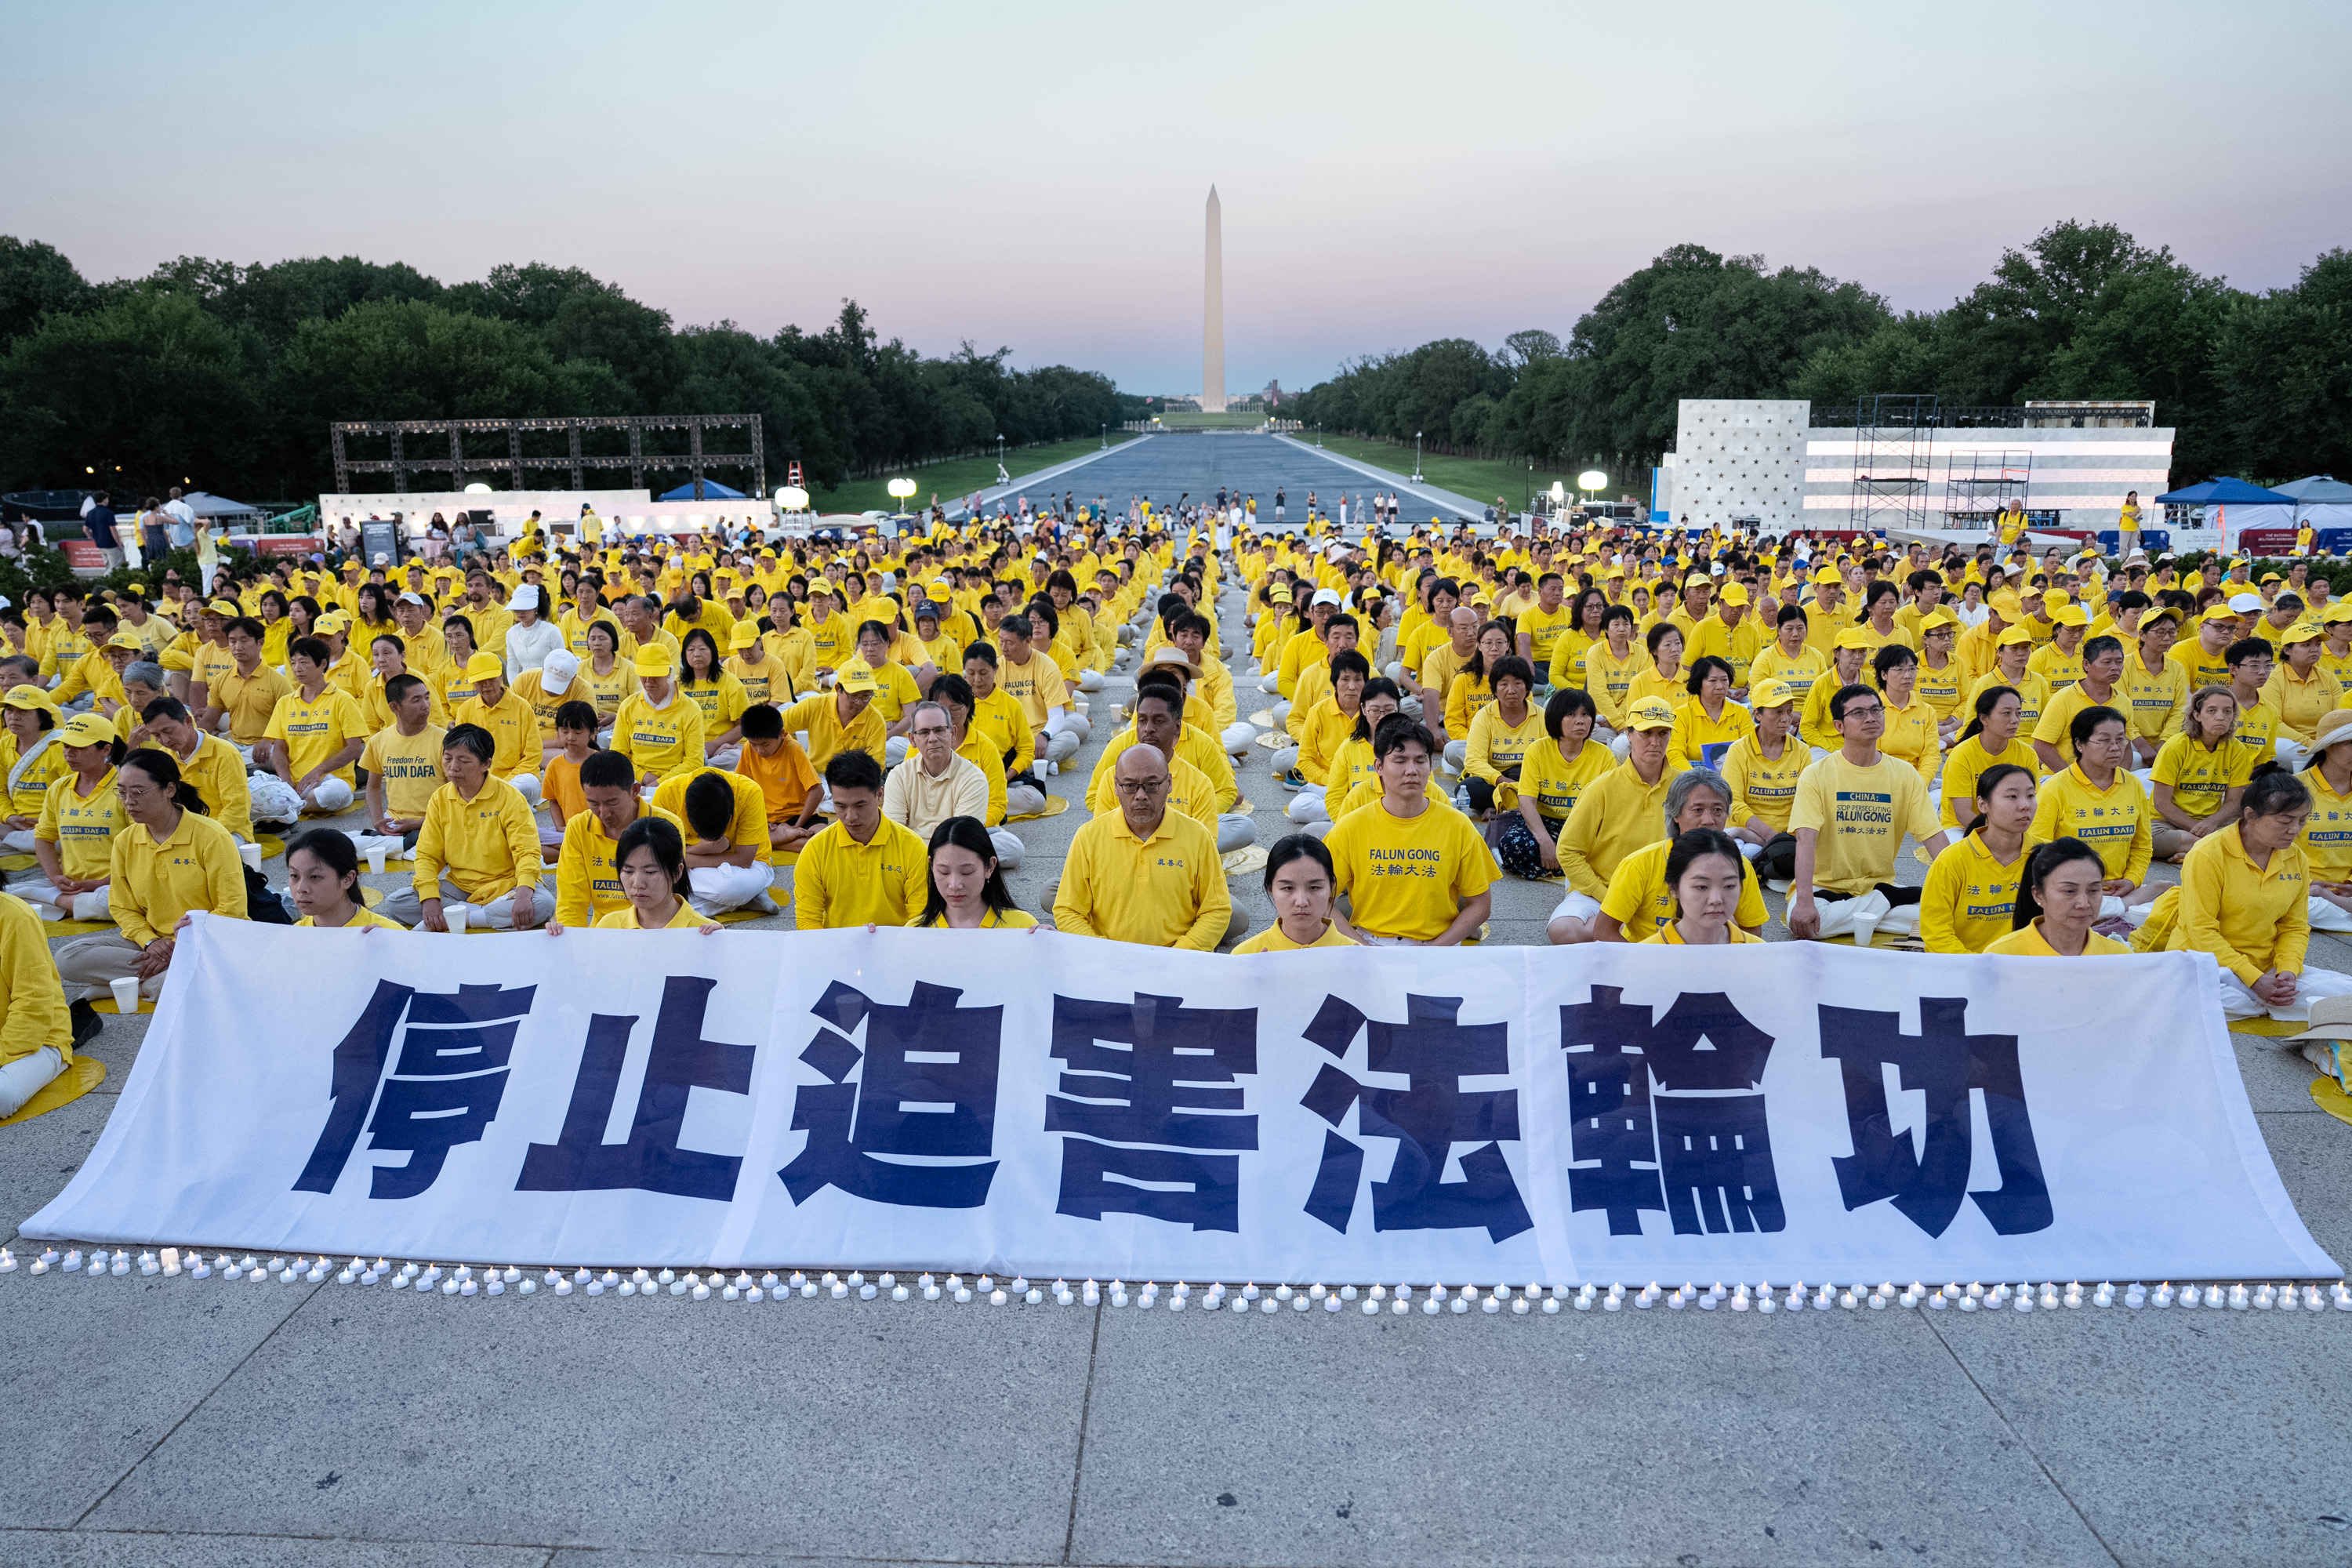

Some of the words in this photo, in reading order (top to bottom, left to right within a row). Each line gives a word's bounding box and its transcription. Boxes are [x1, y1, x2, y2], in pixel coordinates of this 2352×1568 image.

[635, 719, 677, 730] 法輪大法
[387, 756, 413, 764] Freedom
[415, 756, 426, 764] For
[410, 765, 436, 778] DAFA
[1750, 770, 1798, 780] 法輪大法
[1751, 786, 1777, 796] FALUN
[1778, 786, 1796, 795] DAFA
[1540, 795, 1568, 806] FALUN
[1849, 793, 1879, 802] CHINA:
[2075, 804, 2135, 818] 法輪大法
[1836, 811, 1863, 822] FALUN
[1863, 811, 1892, 823] GONG
[84, 827, 107, 836] DAFA
[1838, 826, 1888, 836] 法輪大法好
[2081, 827, 2110, 837] FALUN
[2114, 826, 2134, 835] DAFA
[2312, 833, 2339, 841] FALUN
[1370, 849, 1405, 860] FALUN
[1407, 848, 1439, 862] GONG
[1371, 863, 1437, 877] 法輪大法
[1967, 881, 2020, 895] 法輪大
[1970, 905, 2005, 915] FALUN
[292, 975, 2055, 1245] 停止迫害法輪功
